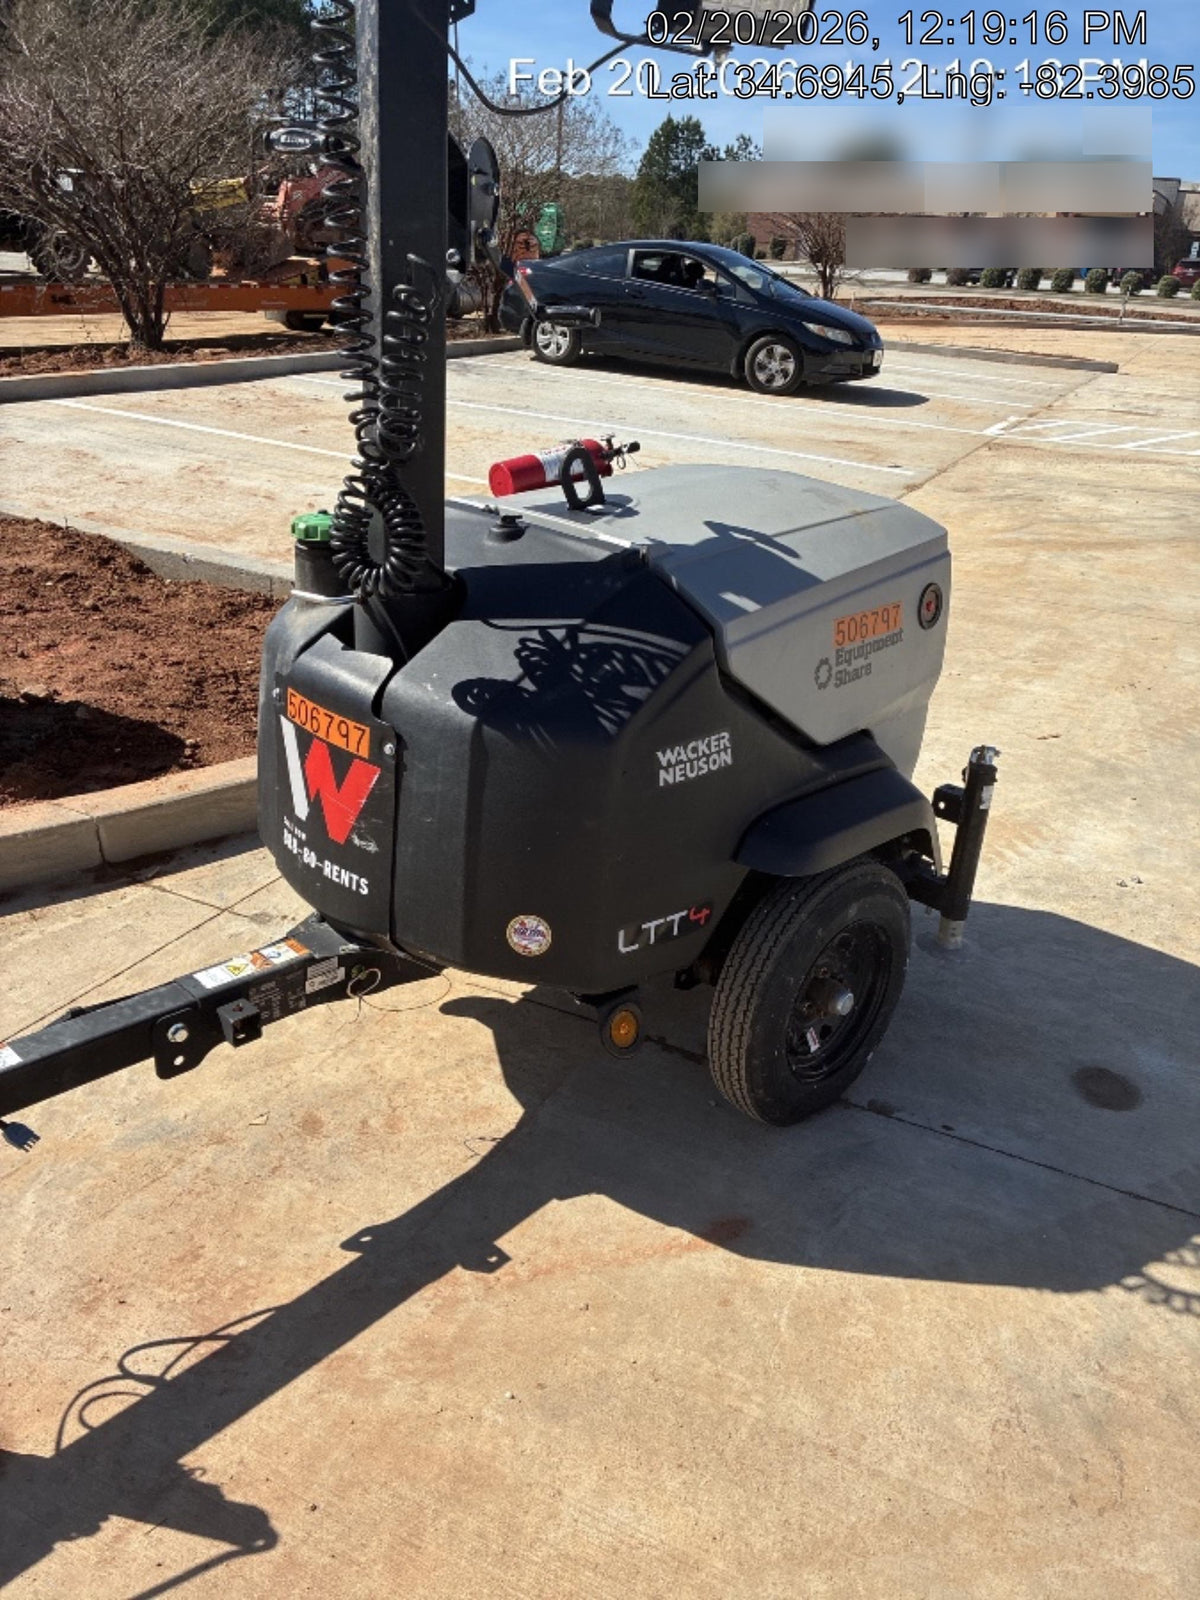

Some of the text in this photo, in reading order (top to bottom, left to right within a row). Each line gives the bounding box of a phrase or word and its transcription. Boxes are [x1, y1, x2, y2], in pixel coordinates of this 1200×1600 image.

[835, 603, 901, 647] 506797
[835, 627, 905, 667] Equipment
[834, 662, 873, 689] Share
[287, 693, 368, 753] 506797
[656, 731, 731, 768] WACKER
[658, 748, 733, 787] NEUSON
